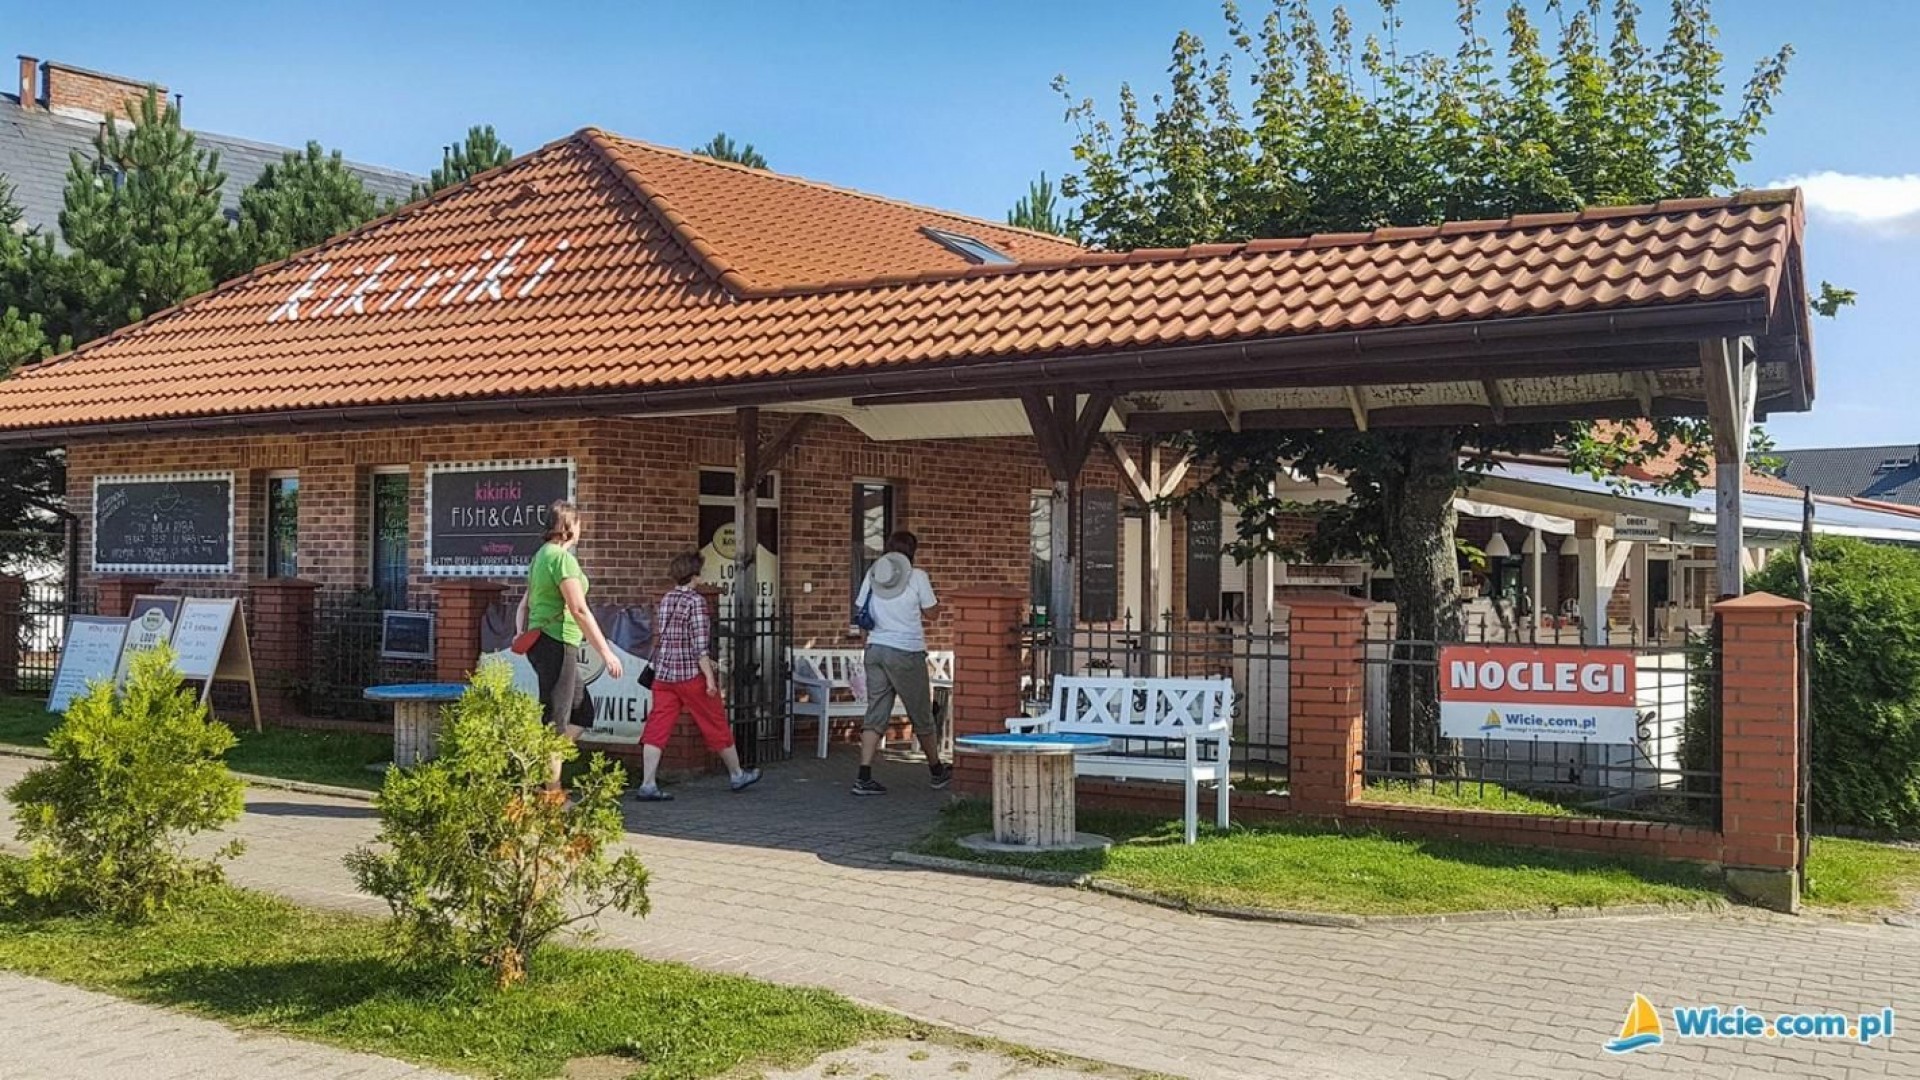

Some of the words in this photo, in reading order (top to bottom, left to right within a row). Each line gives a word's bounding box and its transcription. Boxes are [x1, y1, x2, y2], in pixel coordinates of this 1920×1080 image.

[475, 480, 523, 501] kikiriki
[481, 541, 515, 556] witamy
[1450, 660, 1626, 694] NOCLEGI
[1506, 713, 1597, 729] Wicie.com.pl
